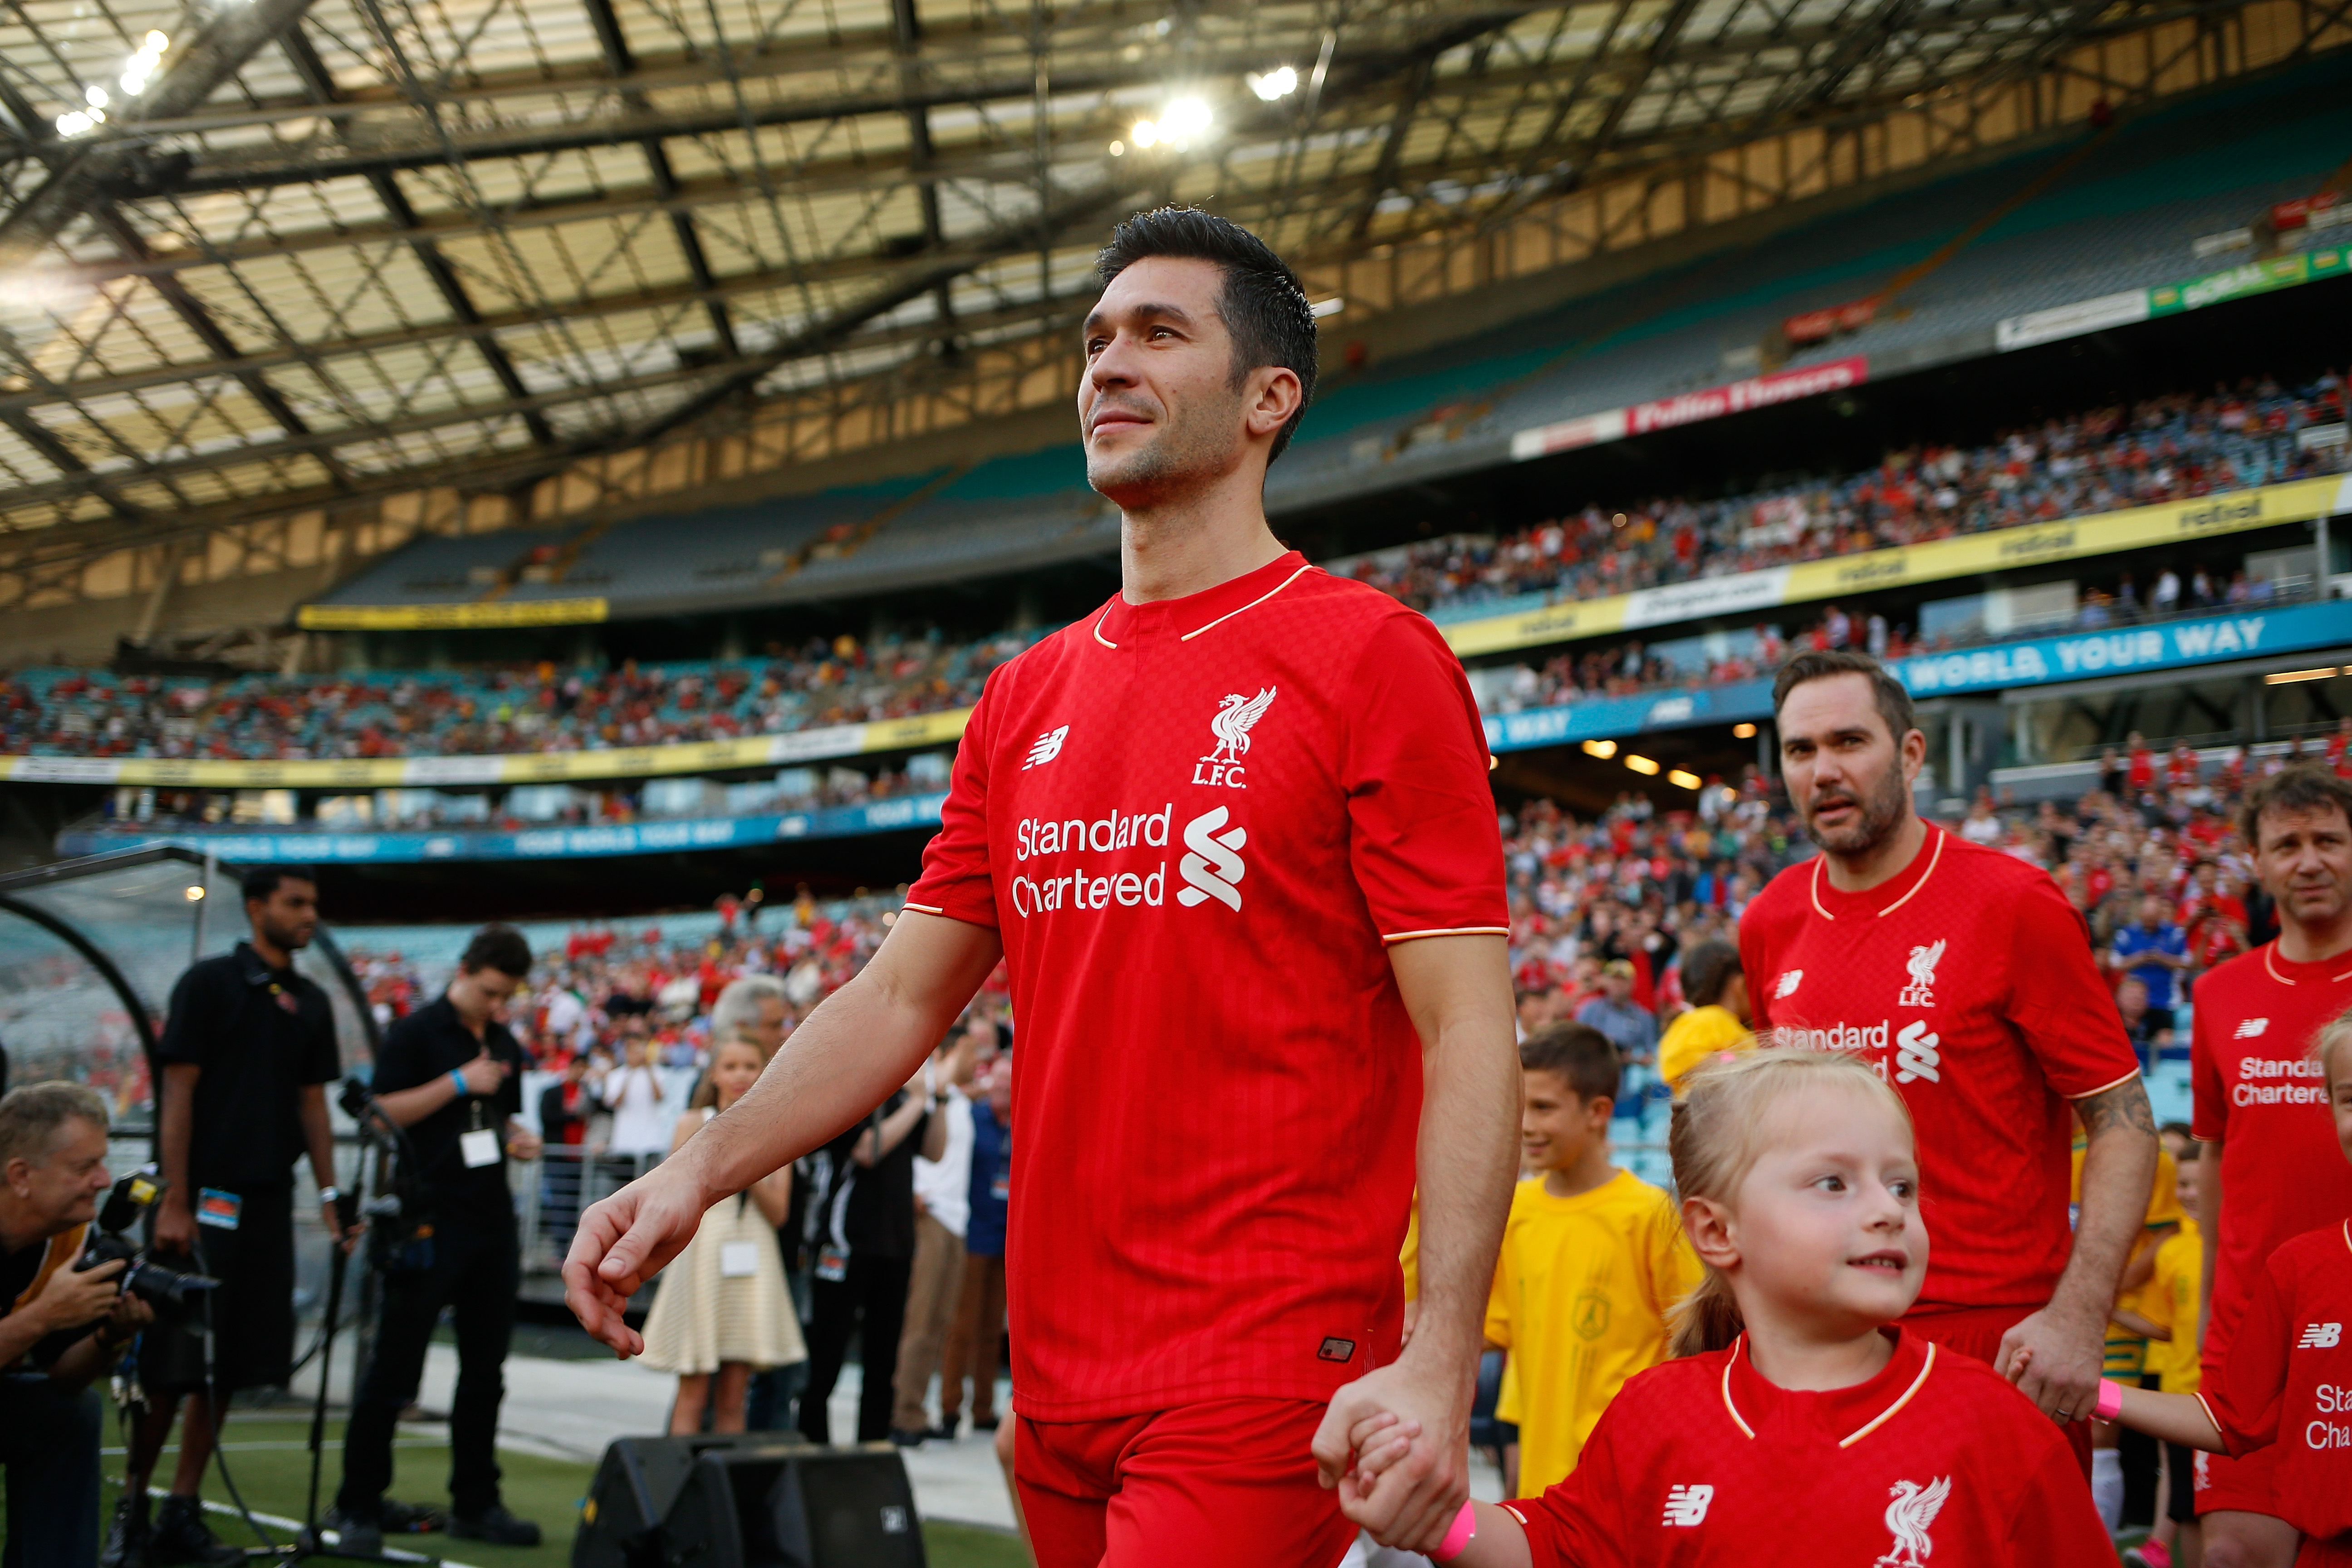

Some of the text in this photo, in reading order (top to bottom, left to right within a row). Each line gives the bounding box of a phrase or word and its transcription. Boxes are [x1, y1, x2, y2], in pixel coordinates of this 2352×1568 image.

[2055, 630, 2164, 672] YOUR
[2175, 617, 2265, 658] WAY
[1191, 764, 1247, 789] L.F.C.
[1017, 803, 1172, 862] Standard
[1012, 861, 1165, 918] Chartered
[1774, 1019, 1889, 1050] Standard
